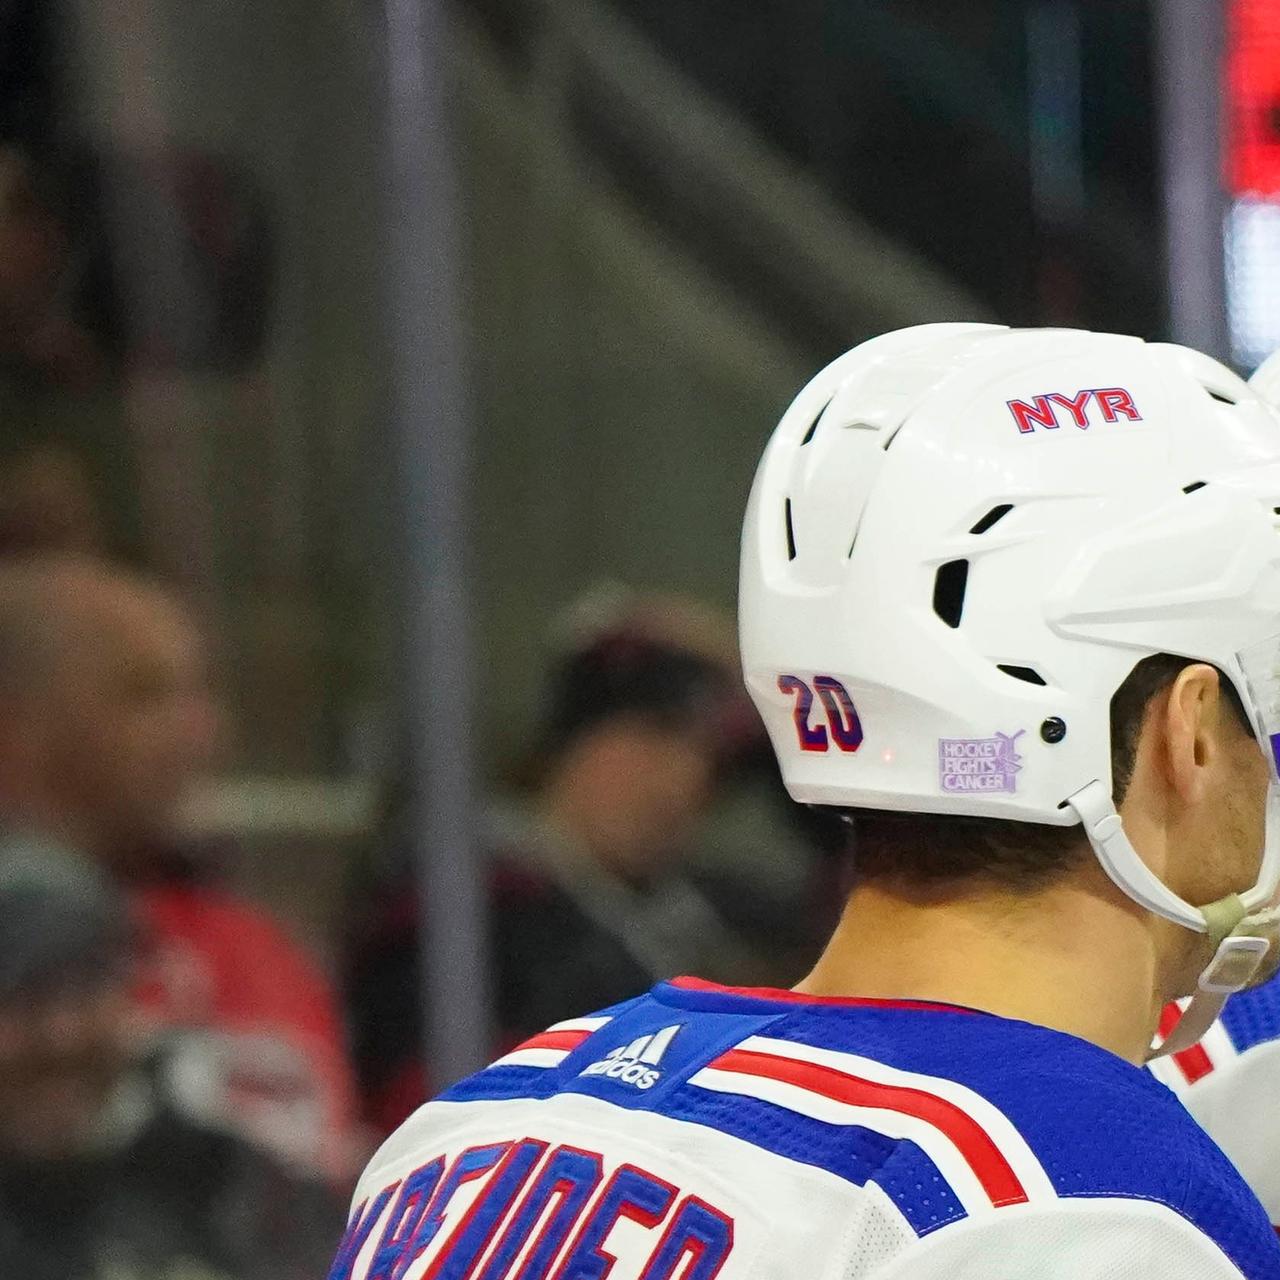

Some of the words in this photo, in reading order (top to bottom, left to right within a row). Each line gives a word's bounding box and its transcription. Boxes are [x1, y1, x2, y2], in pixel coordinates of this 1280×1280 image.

[1006, 388, 1143, 434] NYR
[778, 675, 864, 752] 20
[944, 742, 1002, 757] HOCKEY
[943, 774, 1004, 790] CANCER
